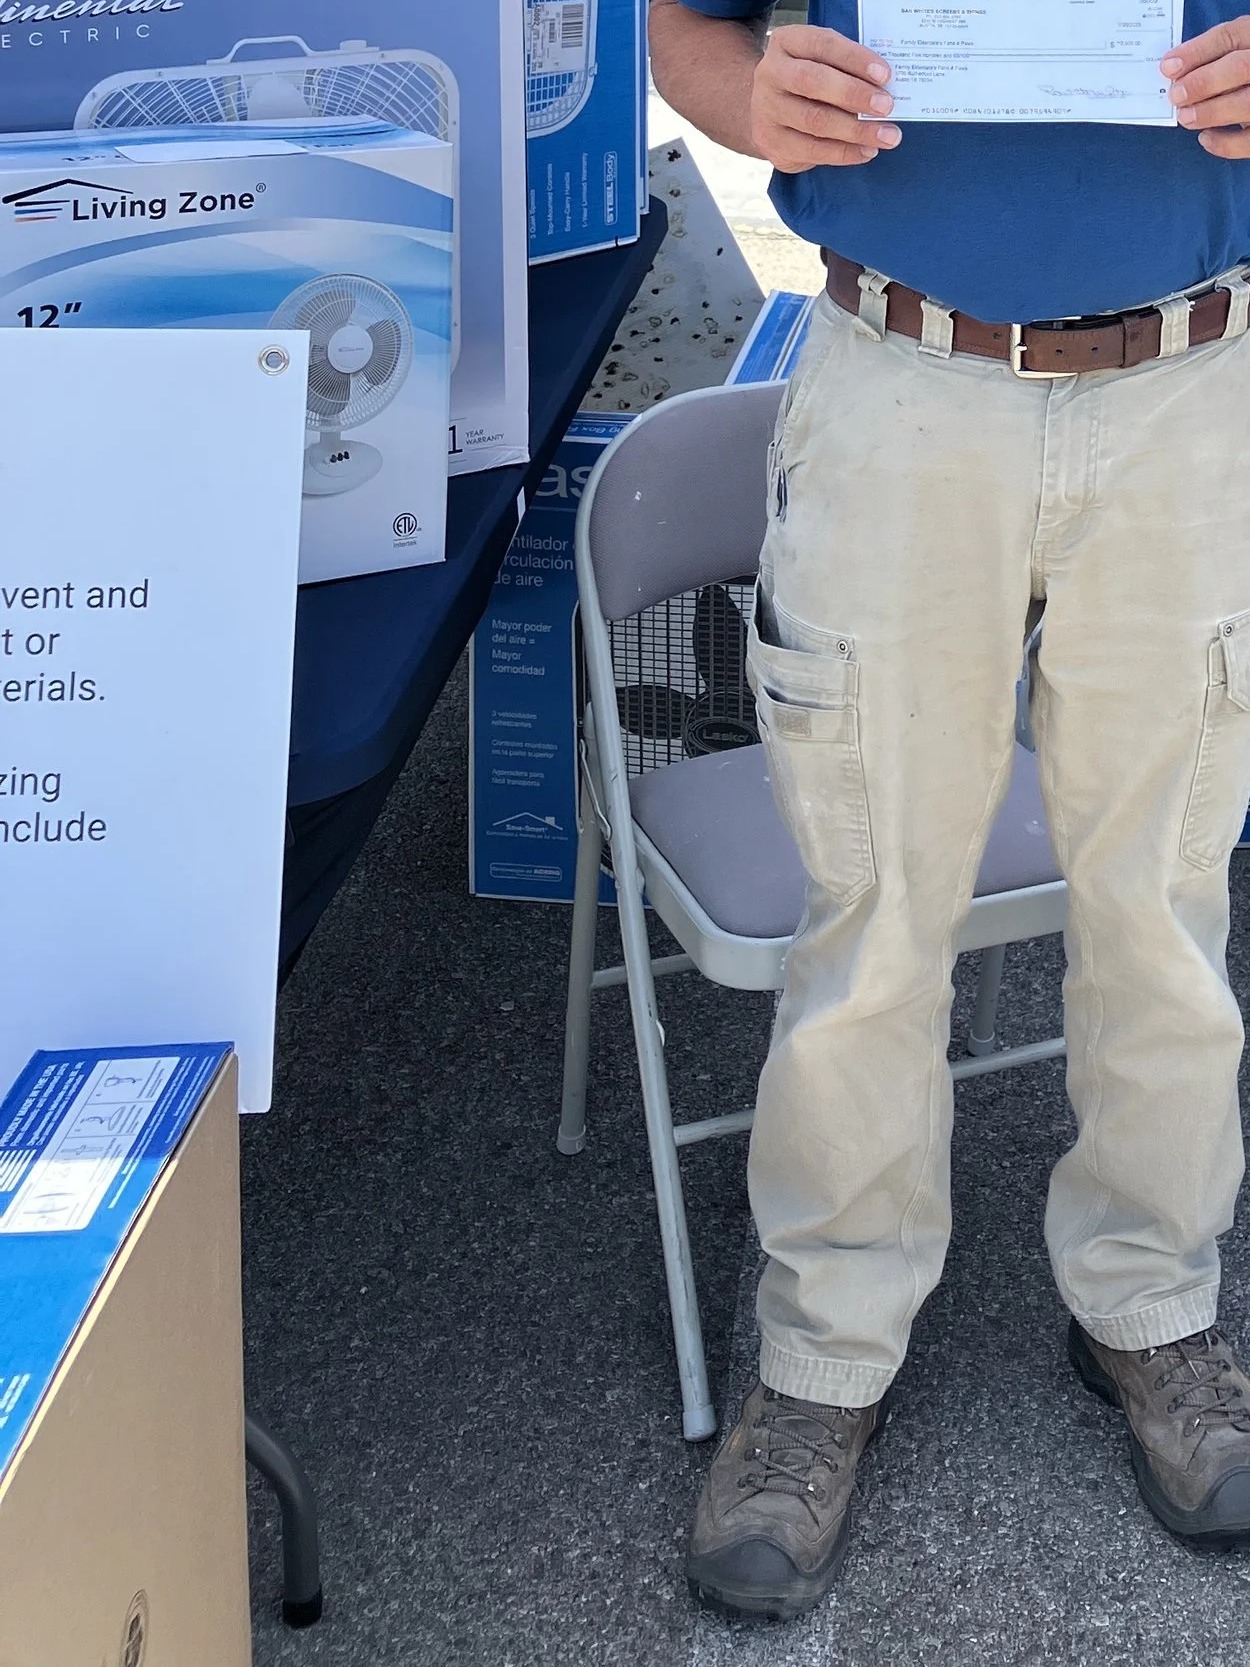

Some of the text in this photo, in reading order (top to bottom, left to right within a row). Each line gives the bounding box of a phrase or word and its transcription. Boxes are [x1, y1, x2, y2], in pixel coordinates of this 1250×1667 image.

[72, 191, 255, 222] Living Zone
[447, 425, 484, 455] 1 YEAR
[466, 433, 505, 445] WARRANTY
[393, 539, 418, 548] Intertek
[86, 578, 150, 609] and
[491, 619, 552, 634] Mayor poder
[25, 633, 61, 655] or
[491, 633, 527, 644] del aire
[491, 650, 522, 662] Mayor
[491, 664, 545, 676] comodidad
